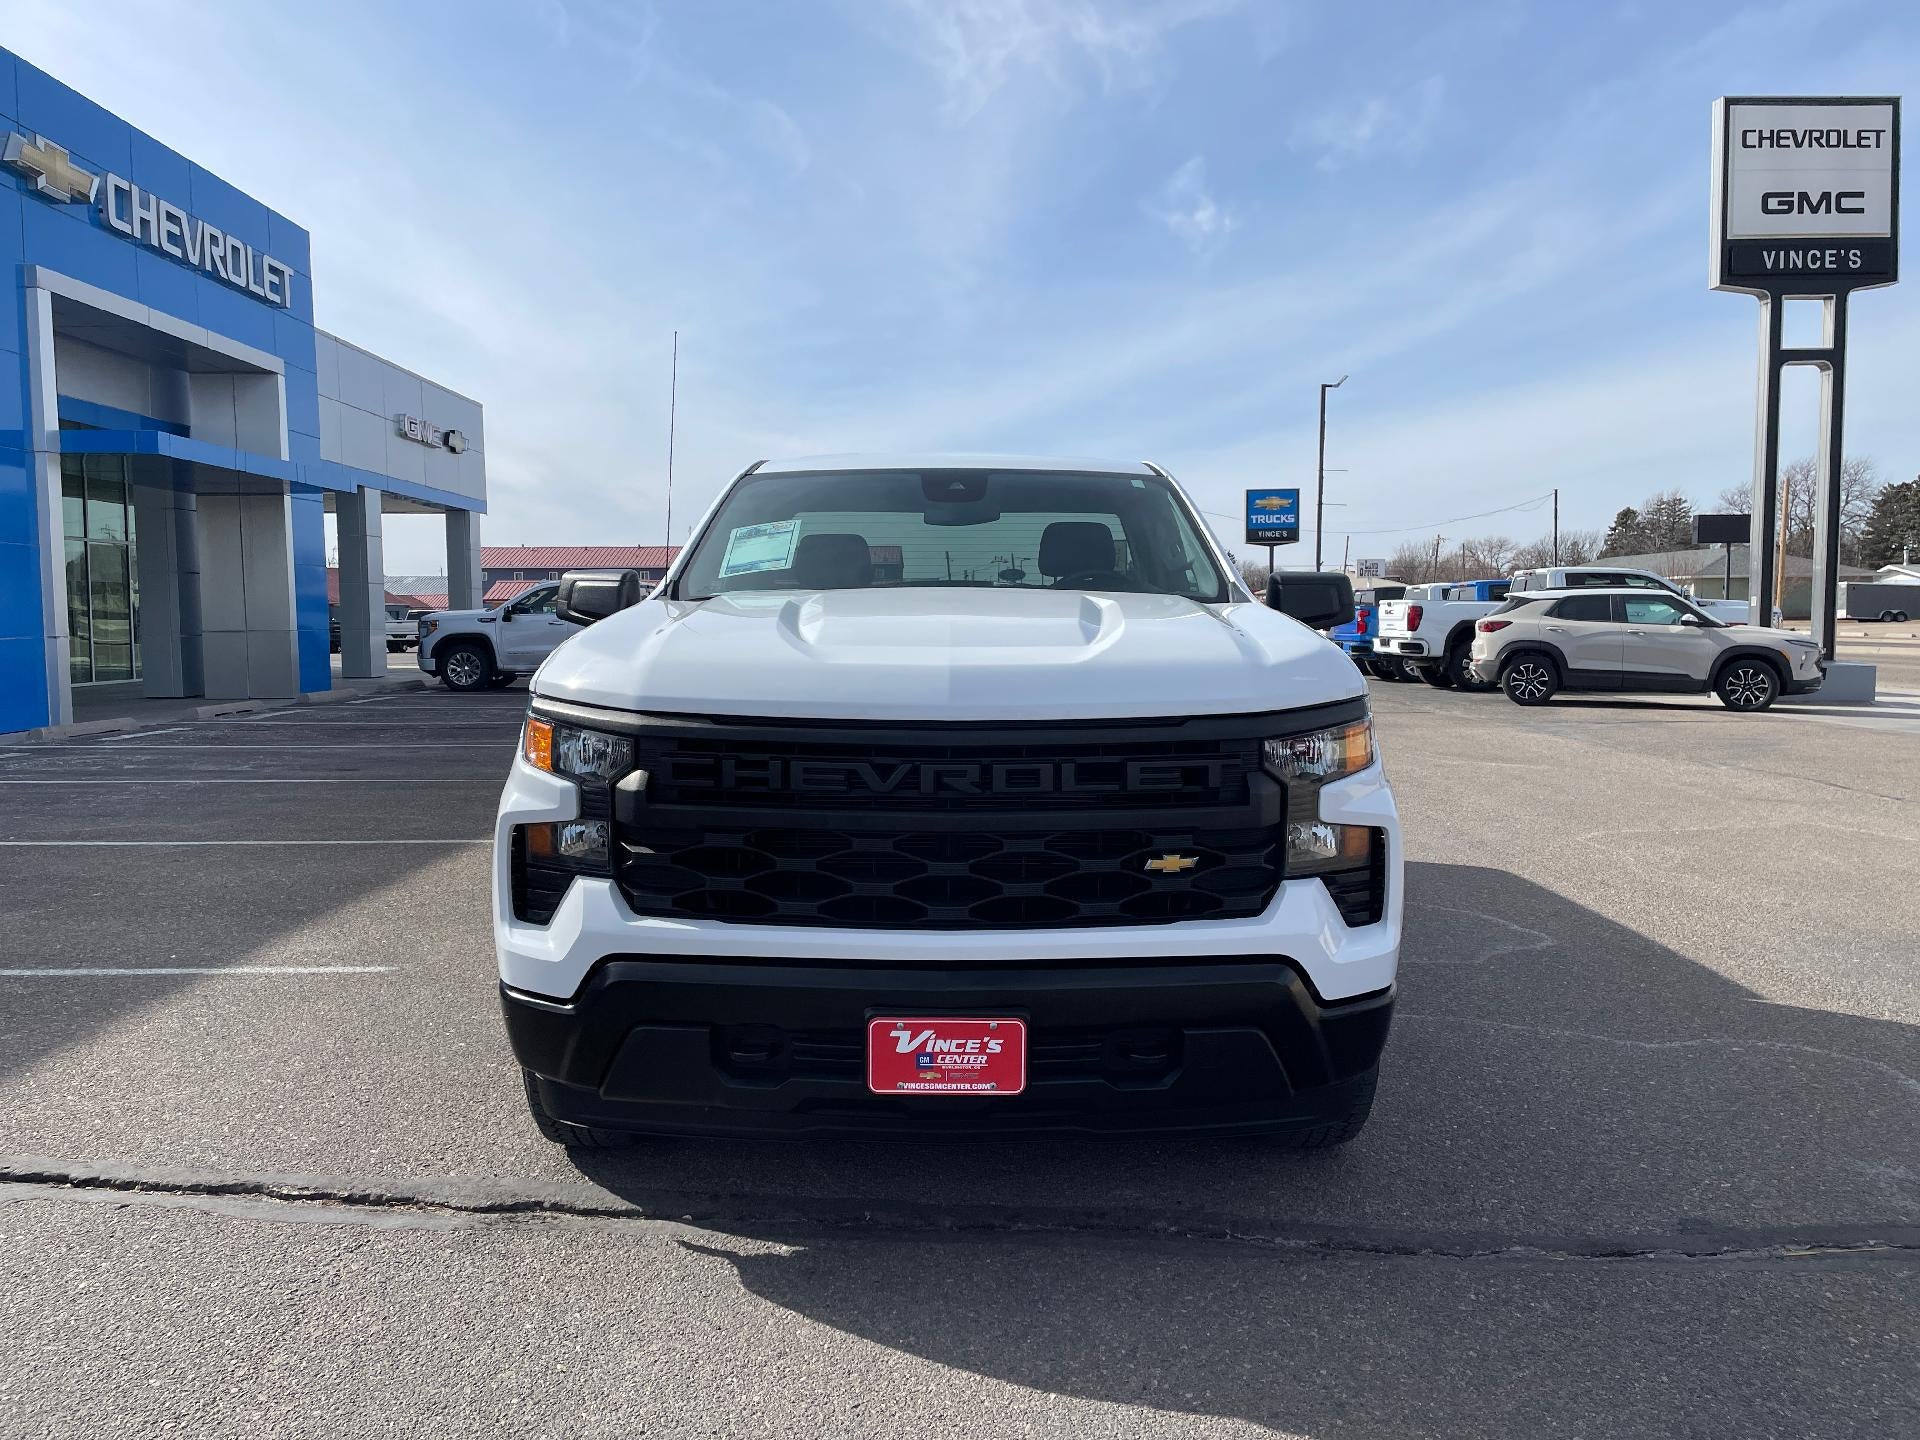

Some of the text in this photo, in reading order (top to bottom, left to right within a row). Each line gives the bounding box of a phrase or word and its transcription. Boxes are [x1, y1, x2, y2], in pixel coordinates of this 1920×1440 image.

[1741, 129, 1886, 149] CHEVROLET
[1761, 191, 1865, 215] GMC
[106, 172, 294, 309] CHEVROLET
[1763, 250, 1862, 269] VINCE'S
[404, 415, 443, 448] GMC
[1250, 514, 1295, 524] TRUCKS
[1258, 530, 1288, 538] VINCE'S
[660, 755, 1241, 794] CHEVROLET
[919, 1056, 930, 1064] GM
[936, 1054, 988, 1064] CENTER
[903, 1082, 991, 1090] VINCESGMCENTER.COM
